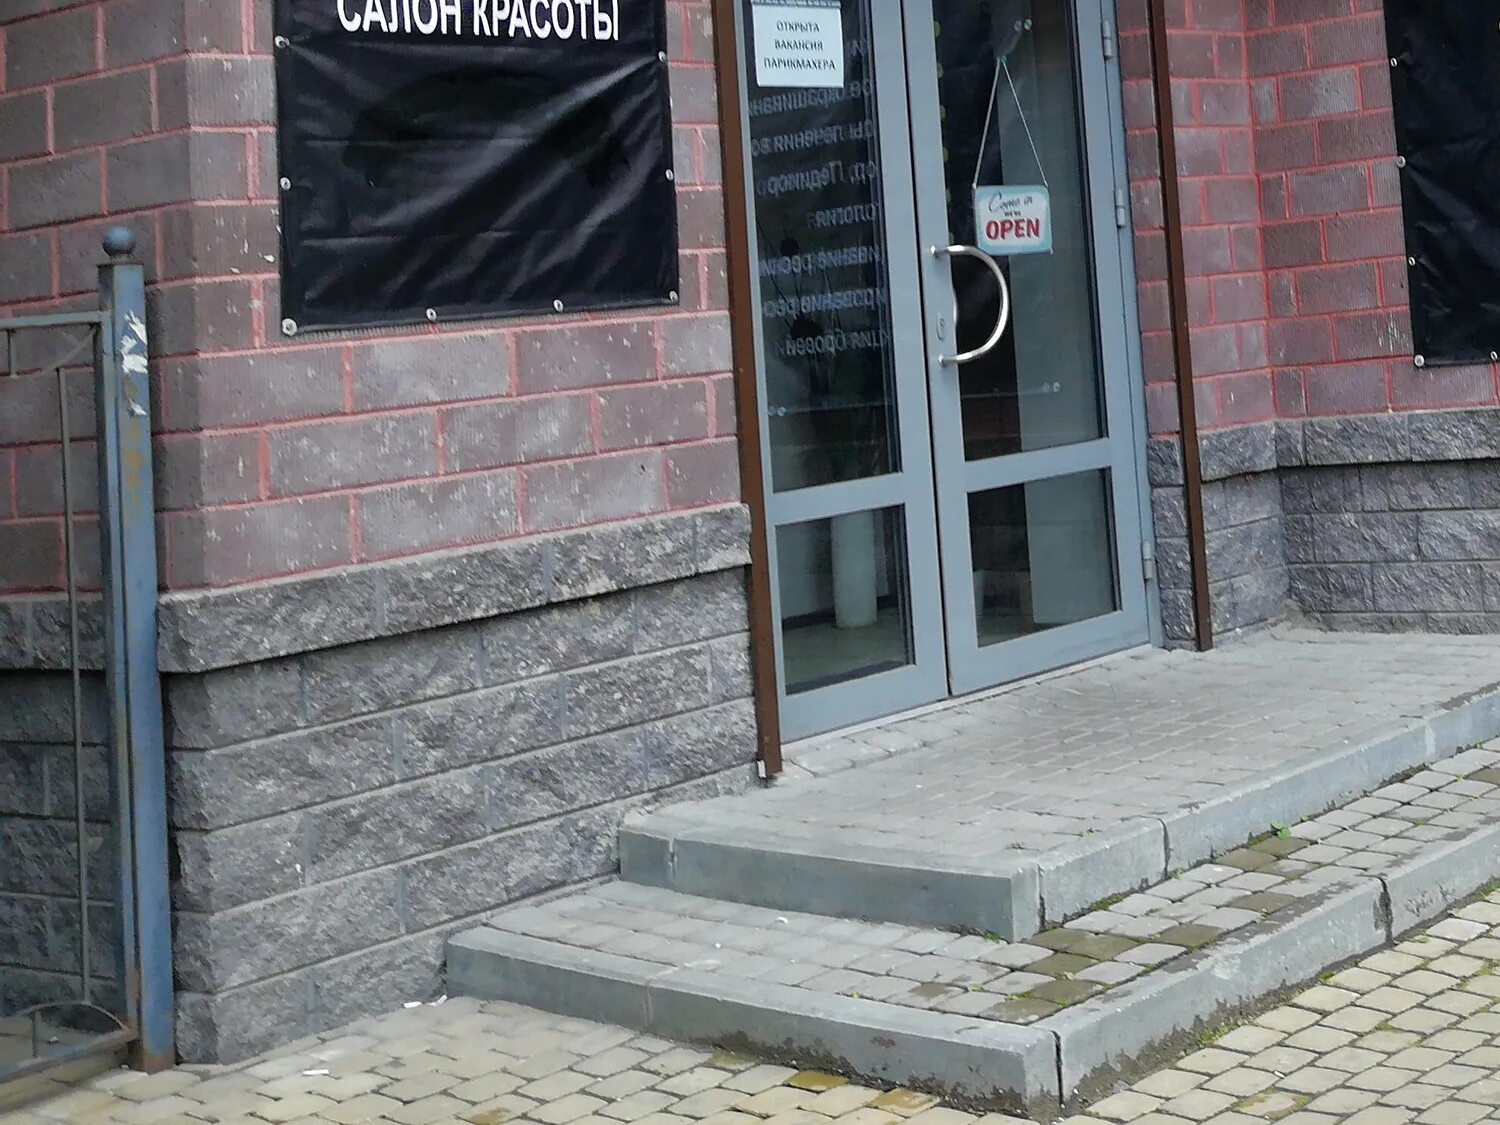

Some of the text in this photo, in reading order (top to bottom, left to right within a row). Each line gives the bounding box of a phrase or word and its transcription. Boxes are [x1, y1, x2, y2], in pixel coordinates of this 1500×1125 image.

[776, 20, 820, 33] ОТКРЫТА
[774, 39, 824, 52] ВАКАНСИЯ
[763, 57, 836, 71] ПАРИКМАХЕРА
[985, 217, 1040, 241] OPEN
